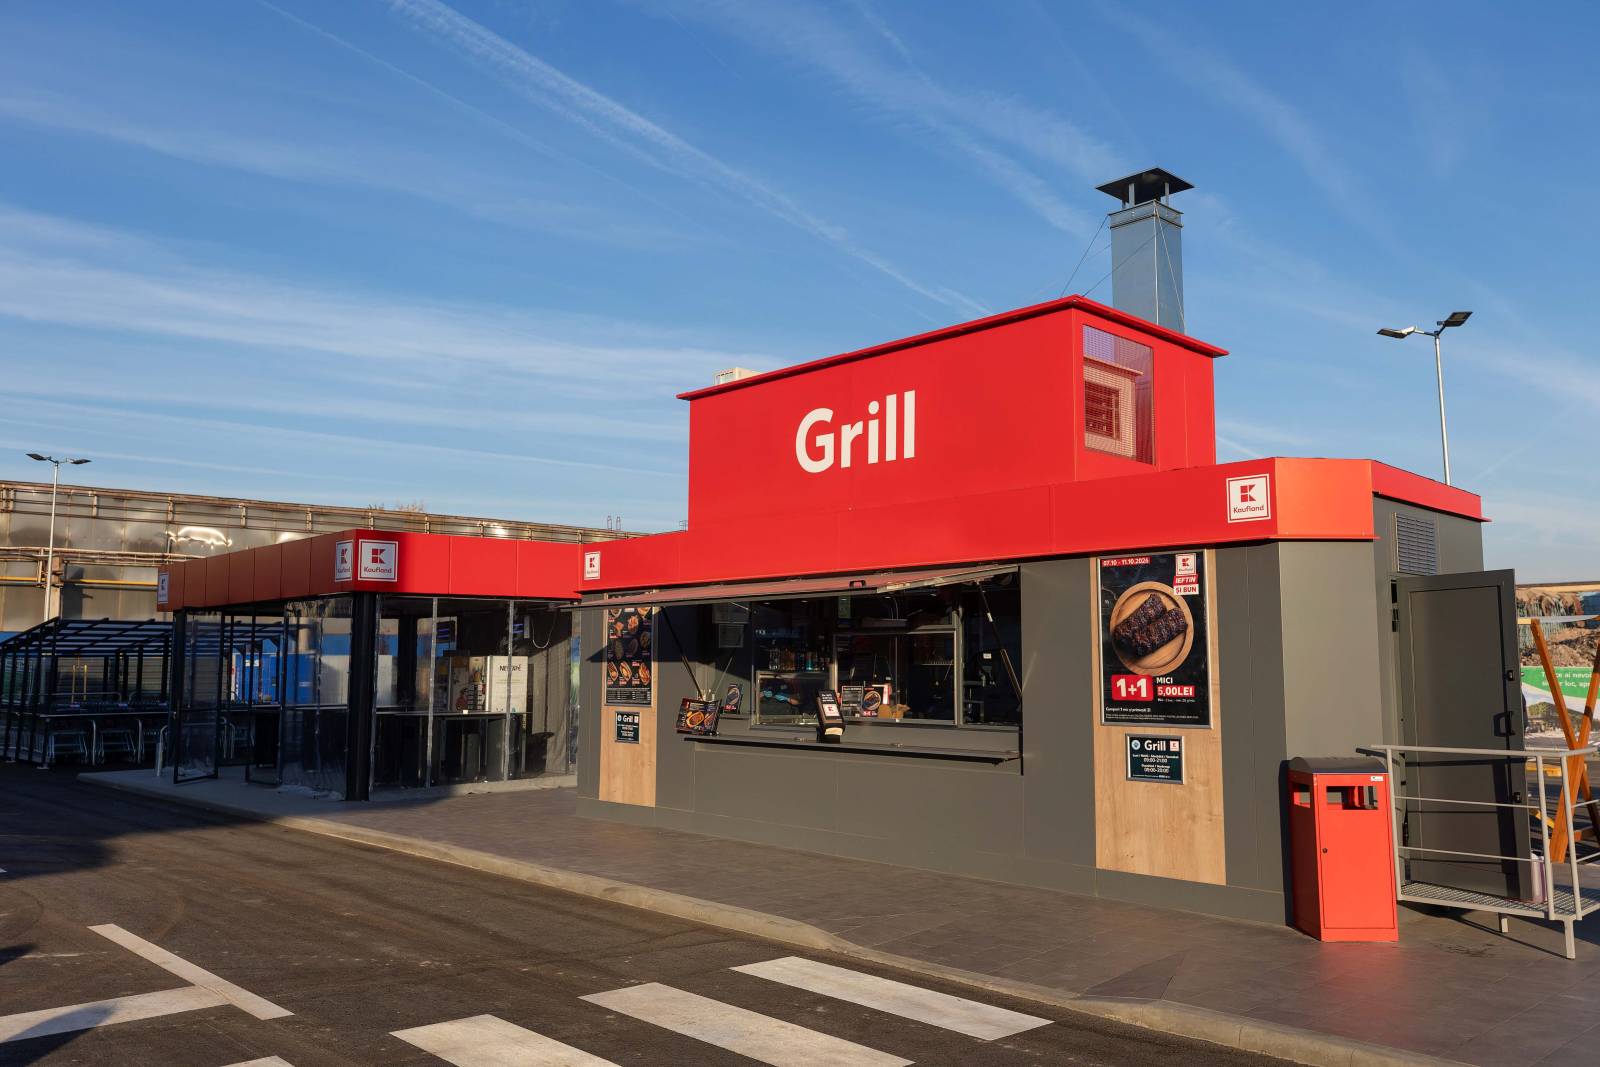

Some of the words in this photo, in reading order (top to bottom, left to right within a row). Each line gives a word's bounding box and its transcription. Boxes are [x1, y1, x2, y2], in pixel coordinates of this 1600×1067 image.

[796, 389, 915, 473] Grill
[1233, 505, 1264, 513] Kaufland
[363, 566, 392, 574] Kaufland
[1116, 678, 1147, 698] 1+1
[1144, 740, 1166, 751] Grill
